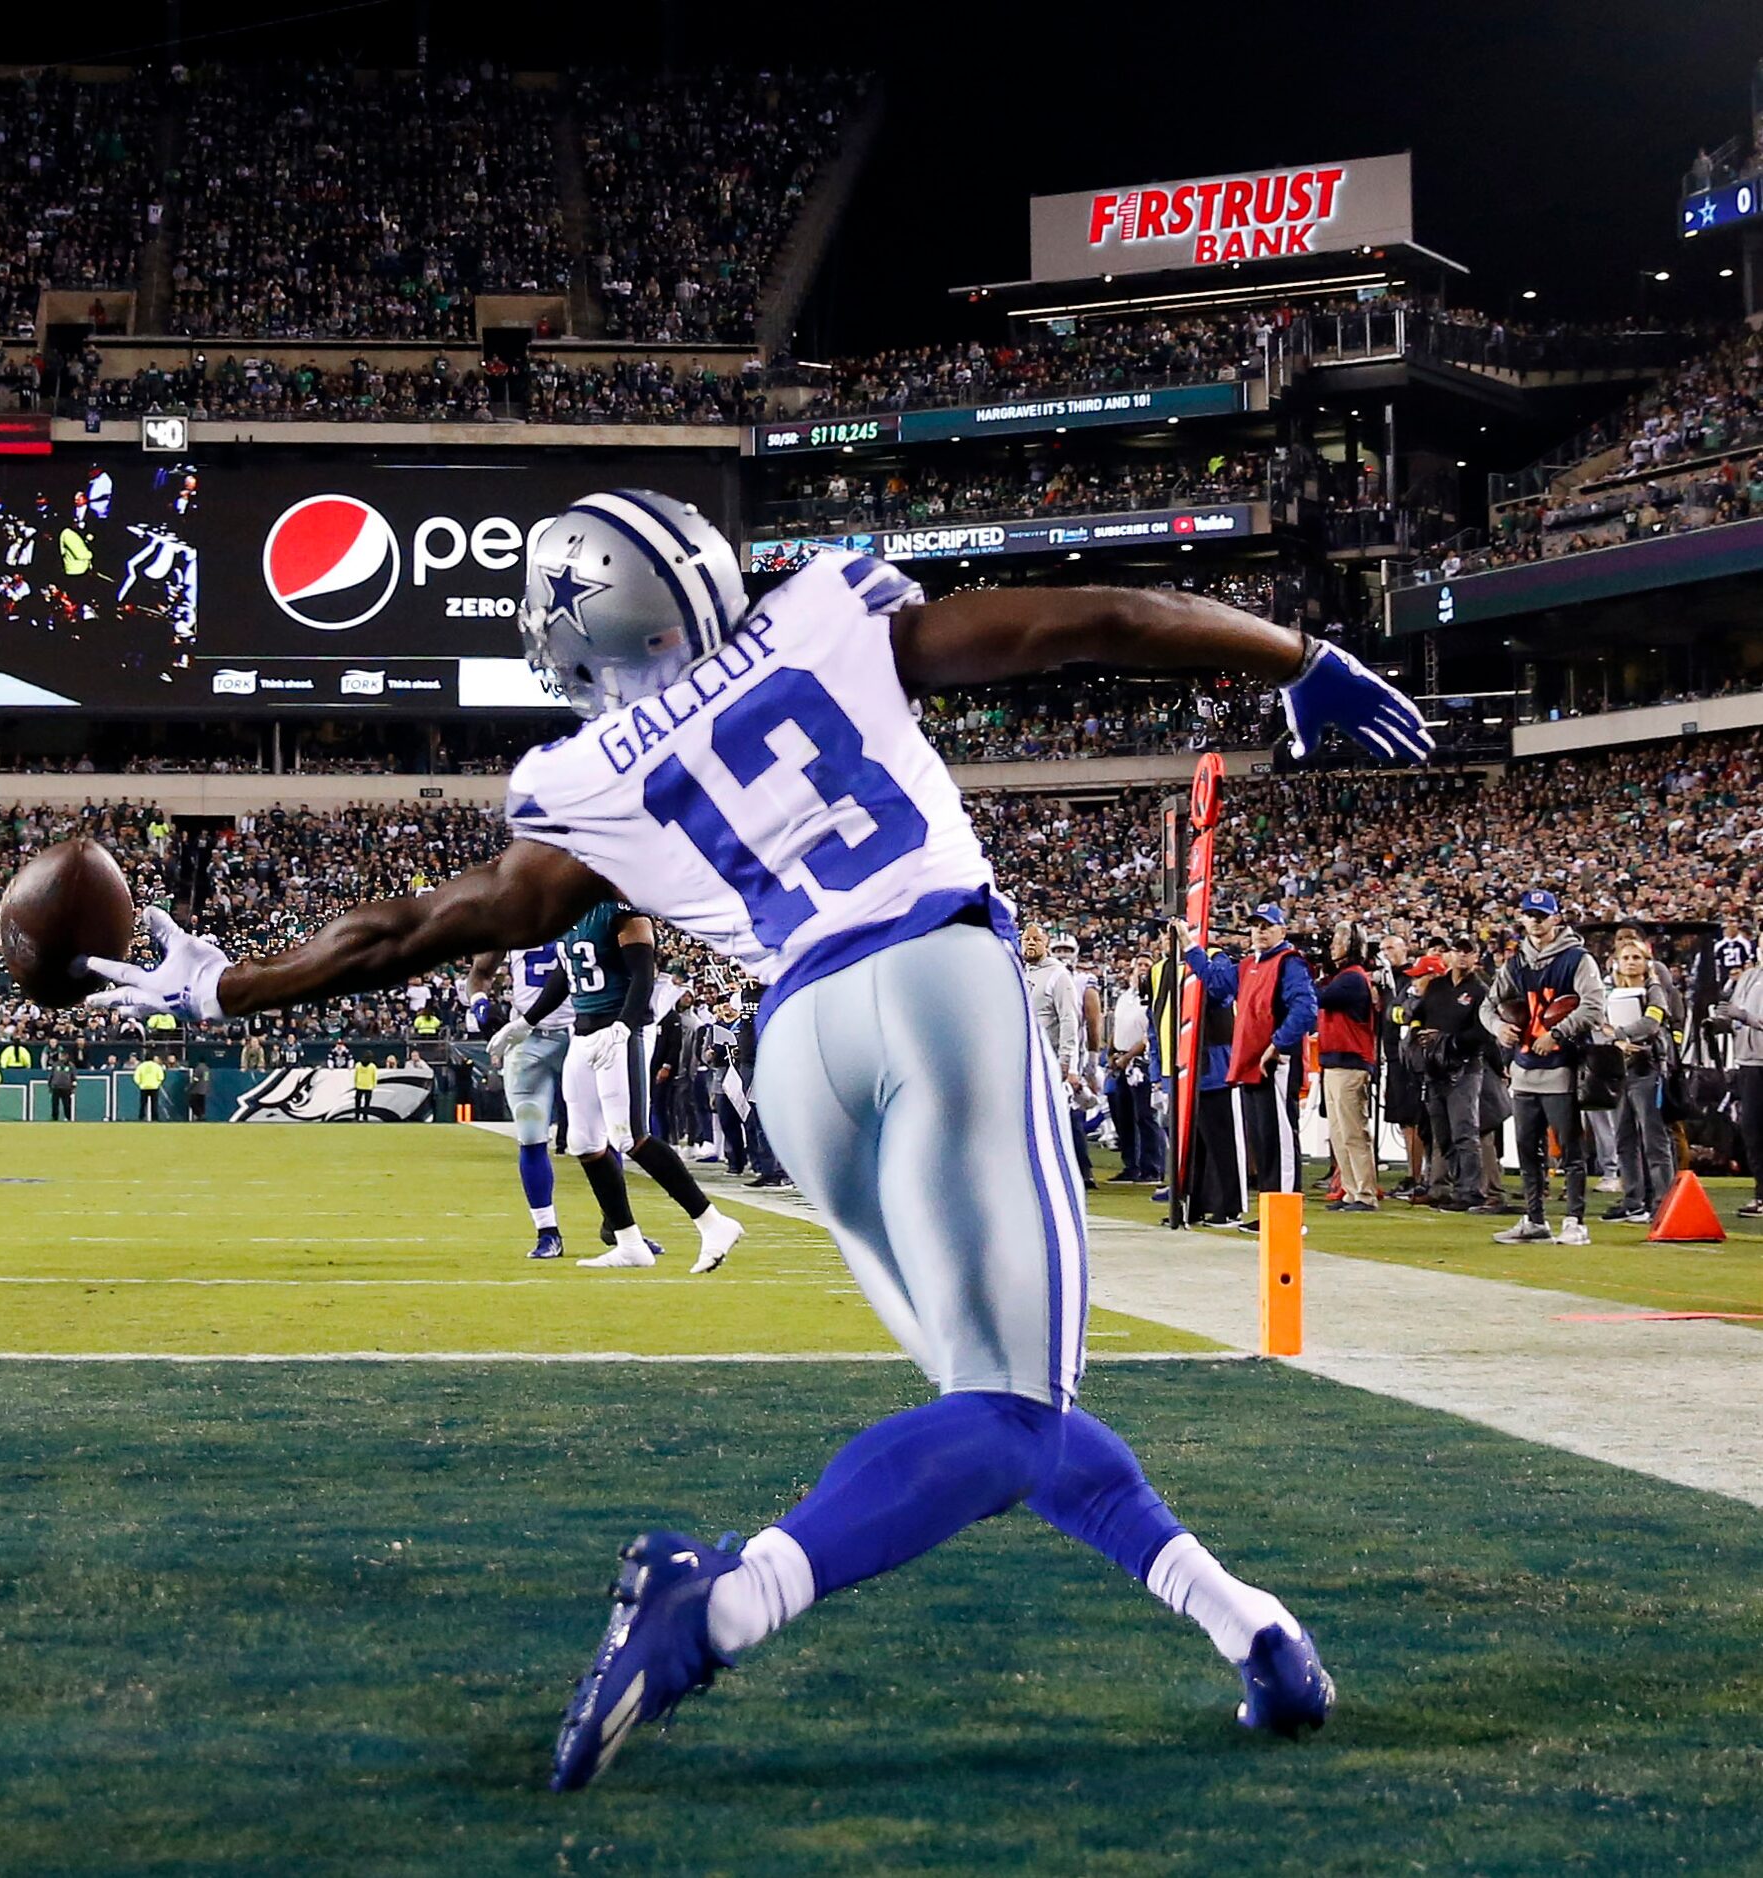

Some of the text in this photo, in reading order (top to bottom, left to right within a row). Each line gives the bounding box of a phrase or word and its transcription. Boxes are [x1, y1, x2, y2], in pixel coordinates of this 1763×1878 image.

[1737, 186, 1752, 214] 0
[1193, 222, 1316, 264] BANK
[1067, 397, 1103, 414] THIRD
[1103, 396, 1131, 410] AND
[1132, 393, 1151, 408] 10!
[147, 420, 183, 448] 40
[810, 421, 879, 446] $118,245
[1093, 524, 1150, 538] SUBSCRIBE
[1151, 522, 1169, 534] ON
[1194, 514, 1235, 532] YouTube
[883, 526, 1006, 554] UNSCRIPTED
[445, 597, 516, 618] ZERO
[216, 678, 252, 690] TORK
[344, 678, 379, 690] TORK
[599, 612, 776, 775] GALLUP
[642, 666, 929, 952] 13
[1723, 947, 1742, 967] 21
